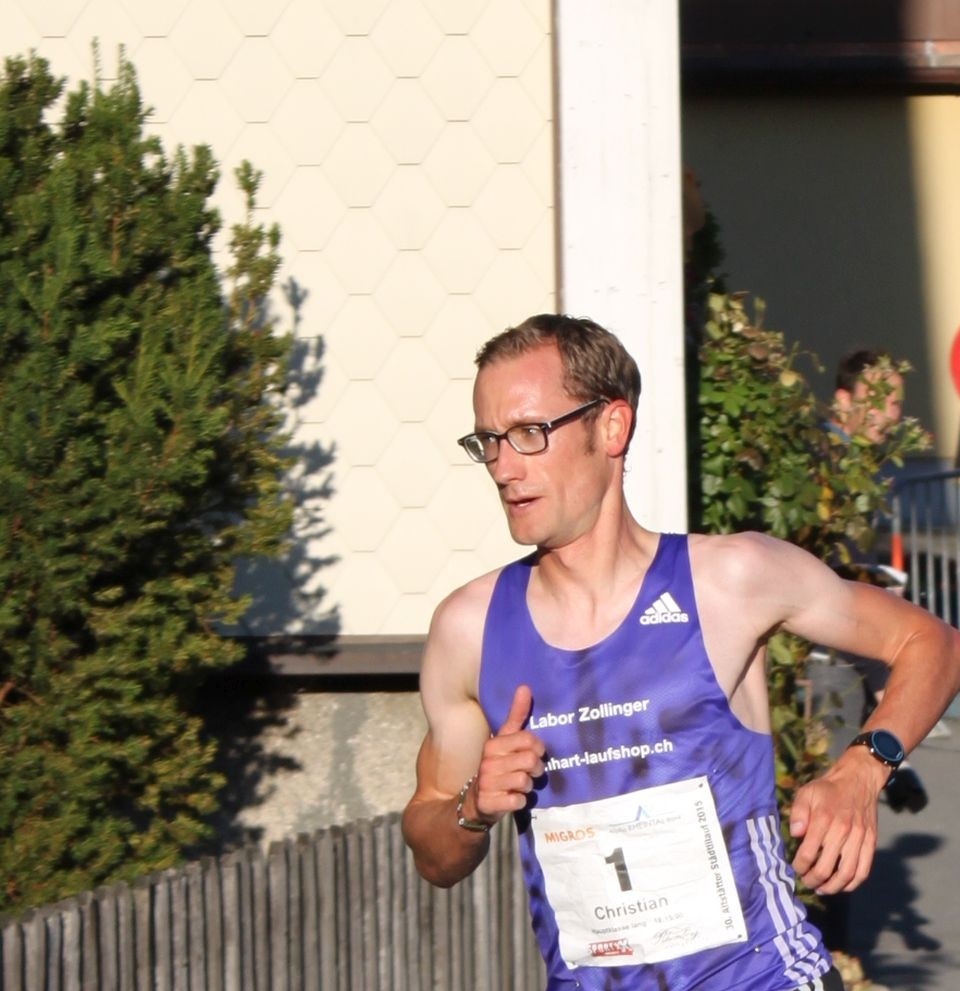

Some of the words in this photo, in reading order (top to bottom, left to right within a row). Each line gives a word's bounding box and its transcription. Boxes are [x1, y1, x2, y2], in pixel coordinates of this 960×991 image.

[639, 612, 689, 625] adidas
[529, 712, 575, 730] Labor
[578, 699, 650, 723] Zollinger
[694, 800, 707, 823] 2015
[544, 827, 596, 843] MIGROS
[604, 847, 633, 892] 1
[594, 896, 669, 921] Christian
